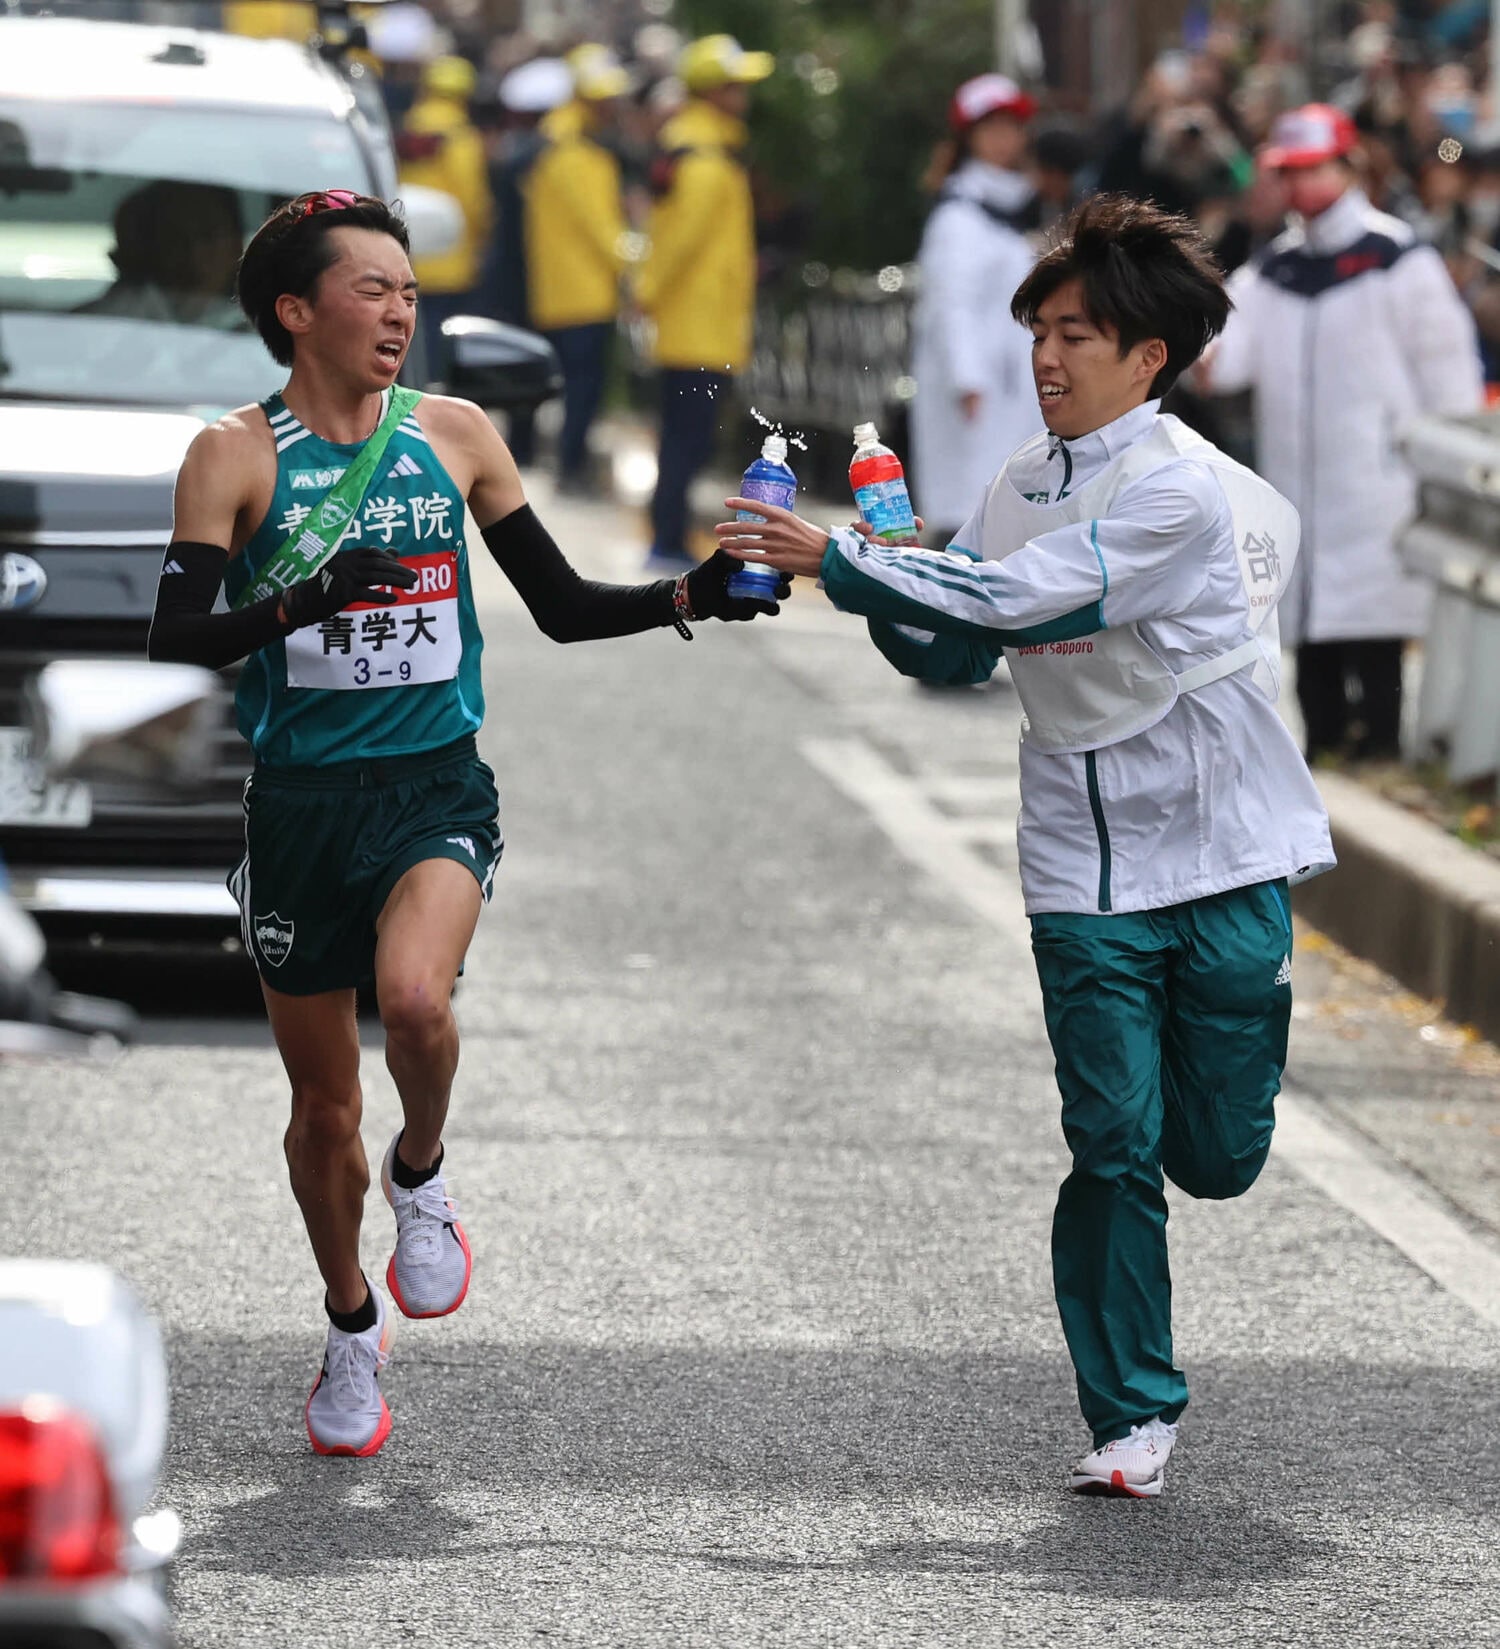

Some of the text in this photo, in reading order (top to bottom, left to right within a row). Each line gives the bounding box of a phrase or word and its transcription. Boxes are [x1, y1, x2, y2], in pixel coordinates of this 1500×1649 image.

[318, 607, 438, 655] 青学大
[1050, 641, 1093, 656] sapporo
